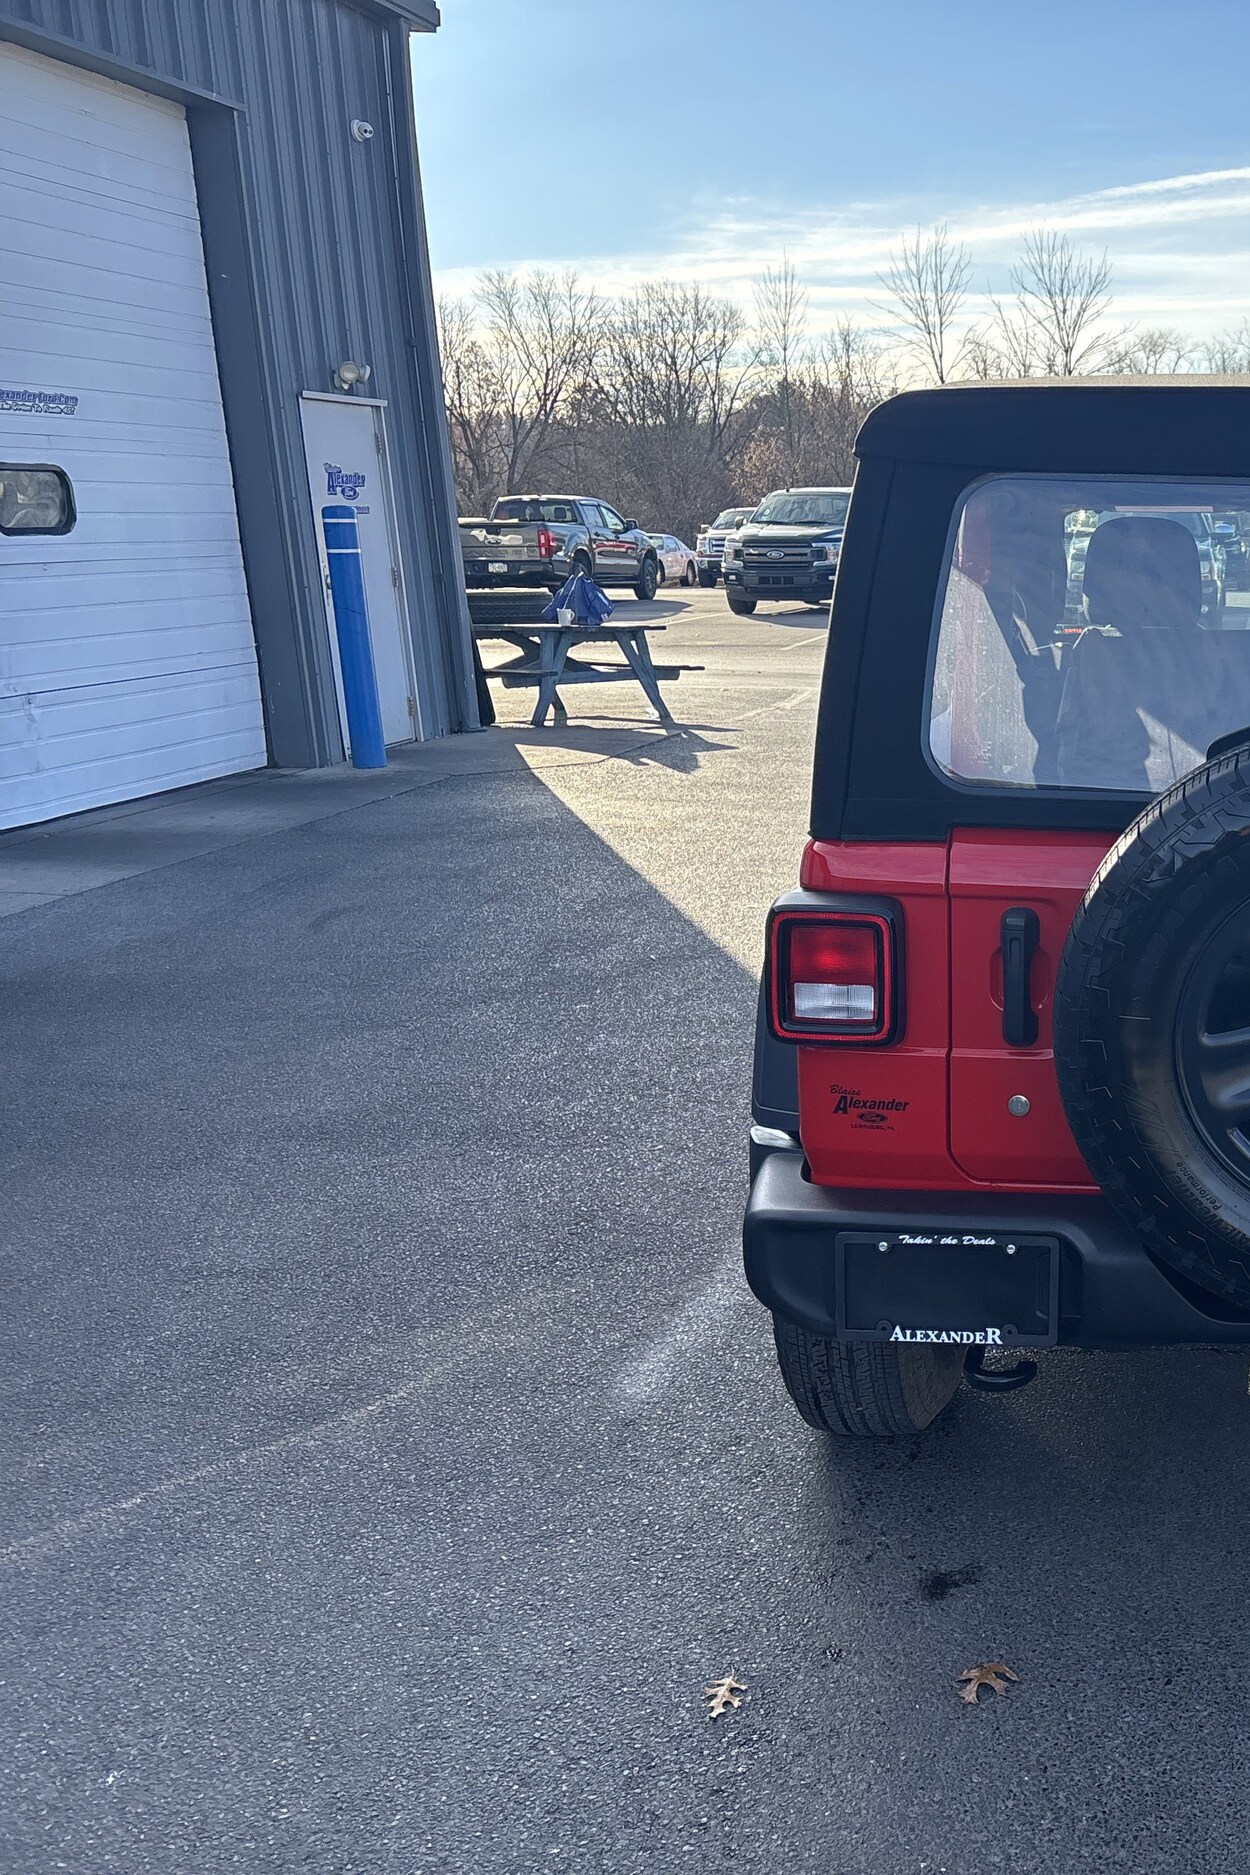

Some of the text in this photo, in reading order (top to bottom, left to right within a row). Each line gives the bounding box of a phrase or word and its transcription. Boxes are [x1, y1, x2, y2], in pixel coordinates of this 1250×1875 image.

[327, 472, 365, 495] Alexander
[830, 1084, 862, 1096] Blaise
[833, 1095, 910, 1115] Alexander
[1175, 1160, 1223, 1212] Performance
[898, 1234, 996, 1246] Takin' the Deals
[889, 1325, 1003, 1345] ALEXANDER
